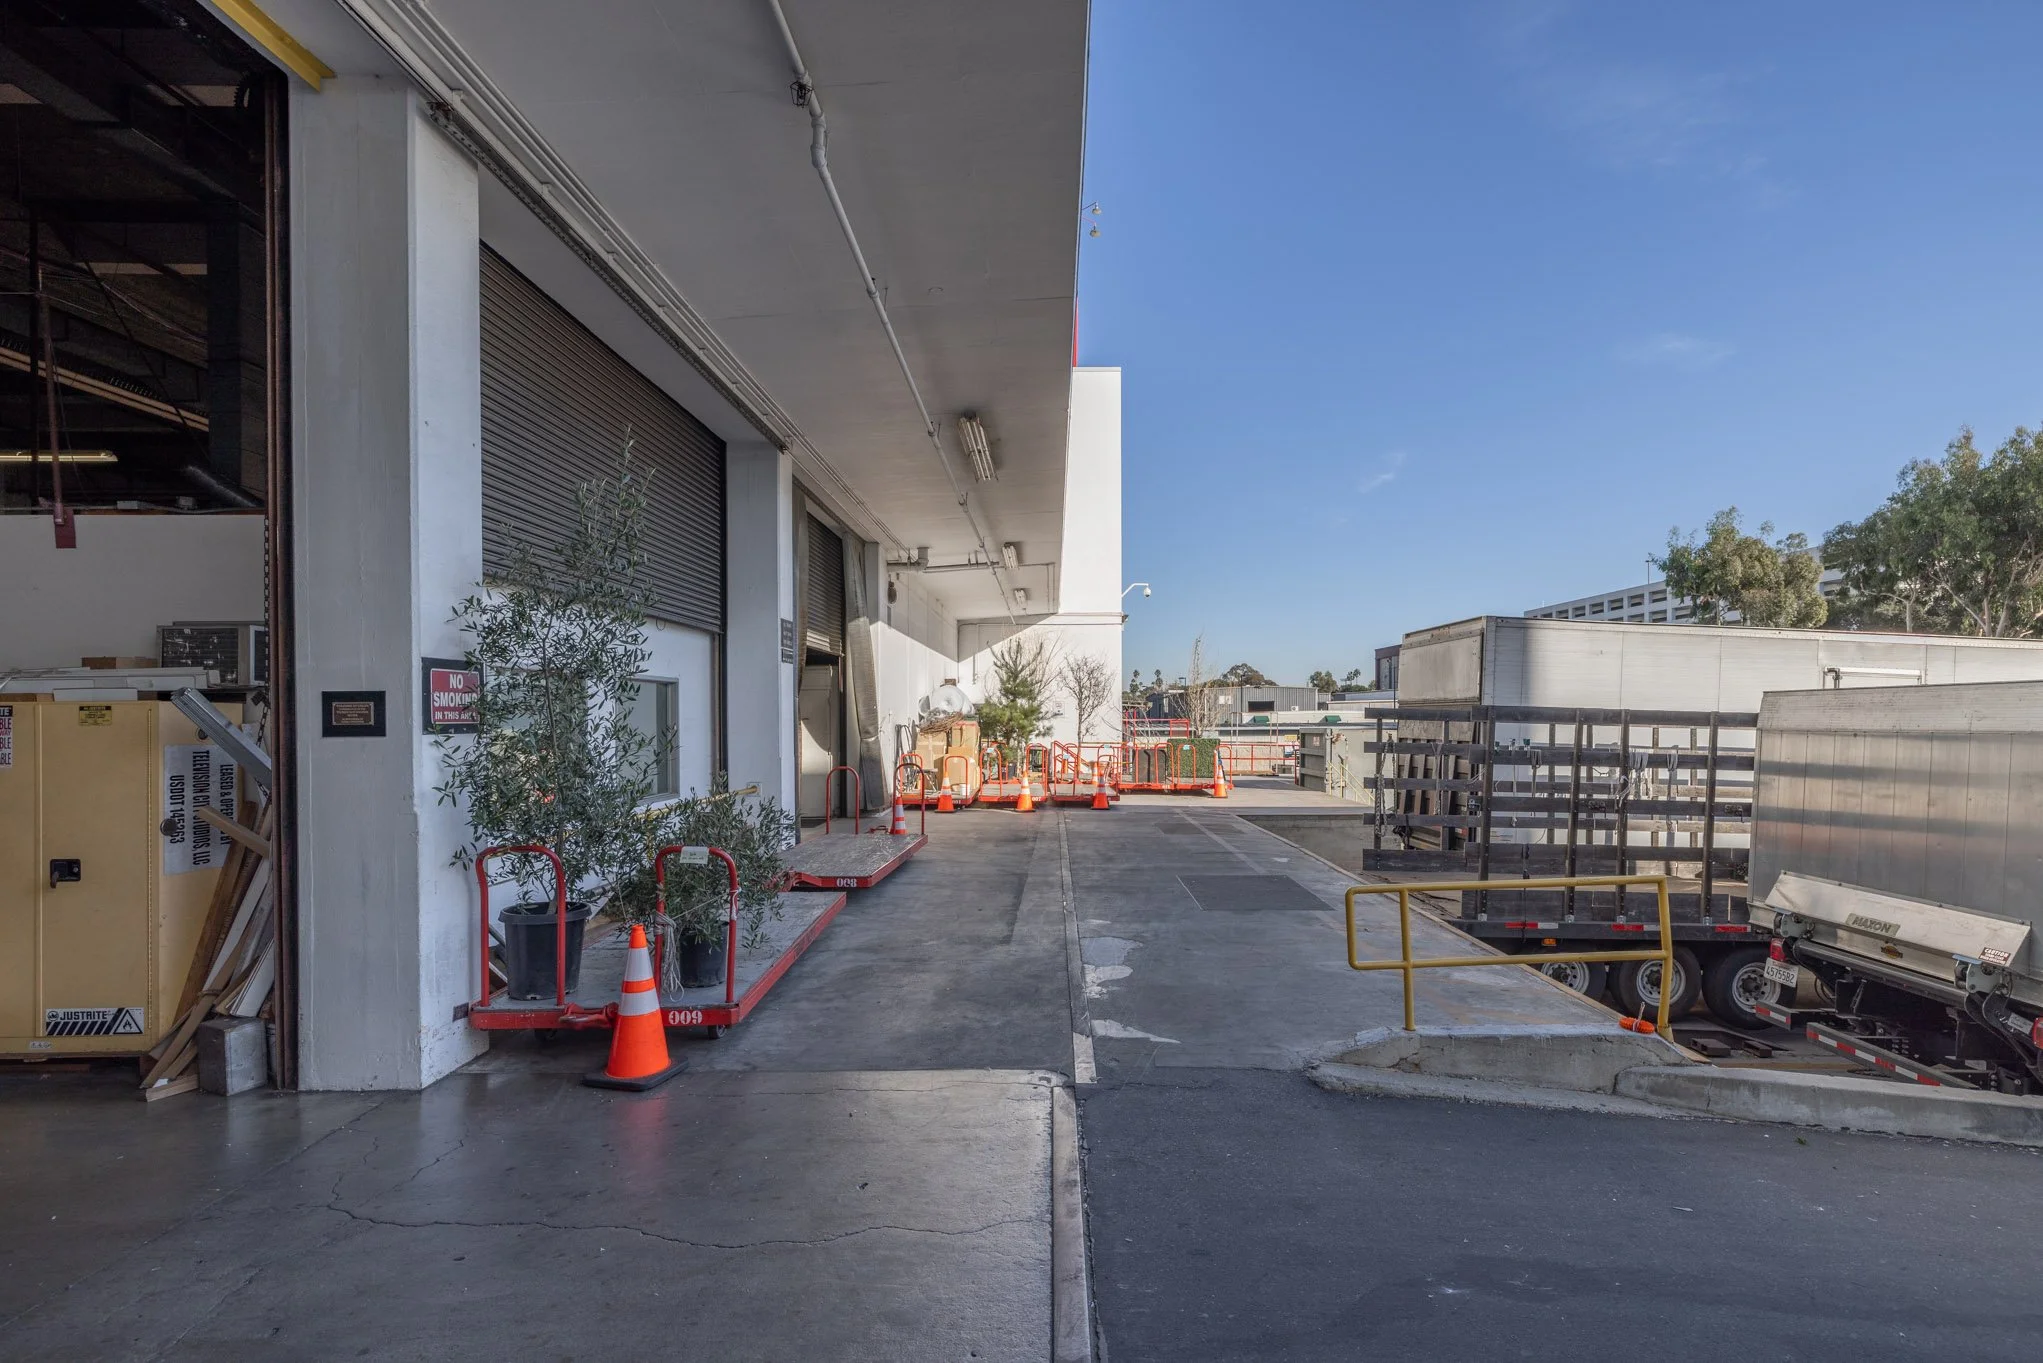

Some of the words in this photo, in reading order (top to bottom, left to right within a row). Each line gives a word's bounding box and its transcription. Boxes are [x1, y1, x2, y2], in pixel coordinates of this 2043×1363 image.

[449, 673, 464, 689] NO
[435, 711, 442, 720] IN
[444, 711, 460, 720] THIS
[192, 750, 210, 794] TELEVISION
[220, 764, 234, 790] LEASED
[170, 774, 185, 806] USDOT
[192, 851, 210, 866] LLC
[1852, 916, 1892, 934] MAXON
[60, 1010, 108, 1020] JUSTRITE
[668, 1010, 702, 1024] 009
